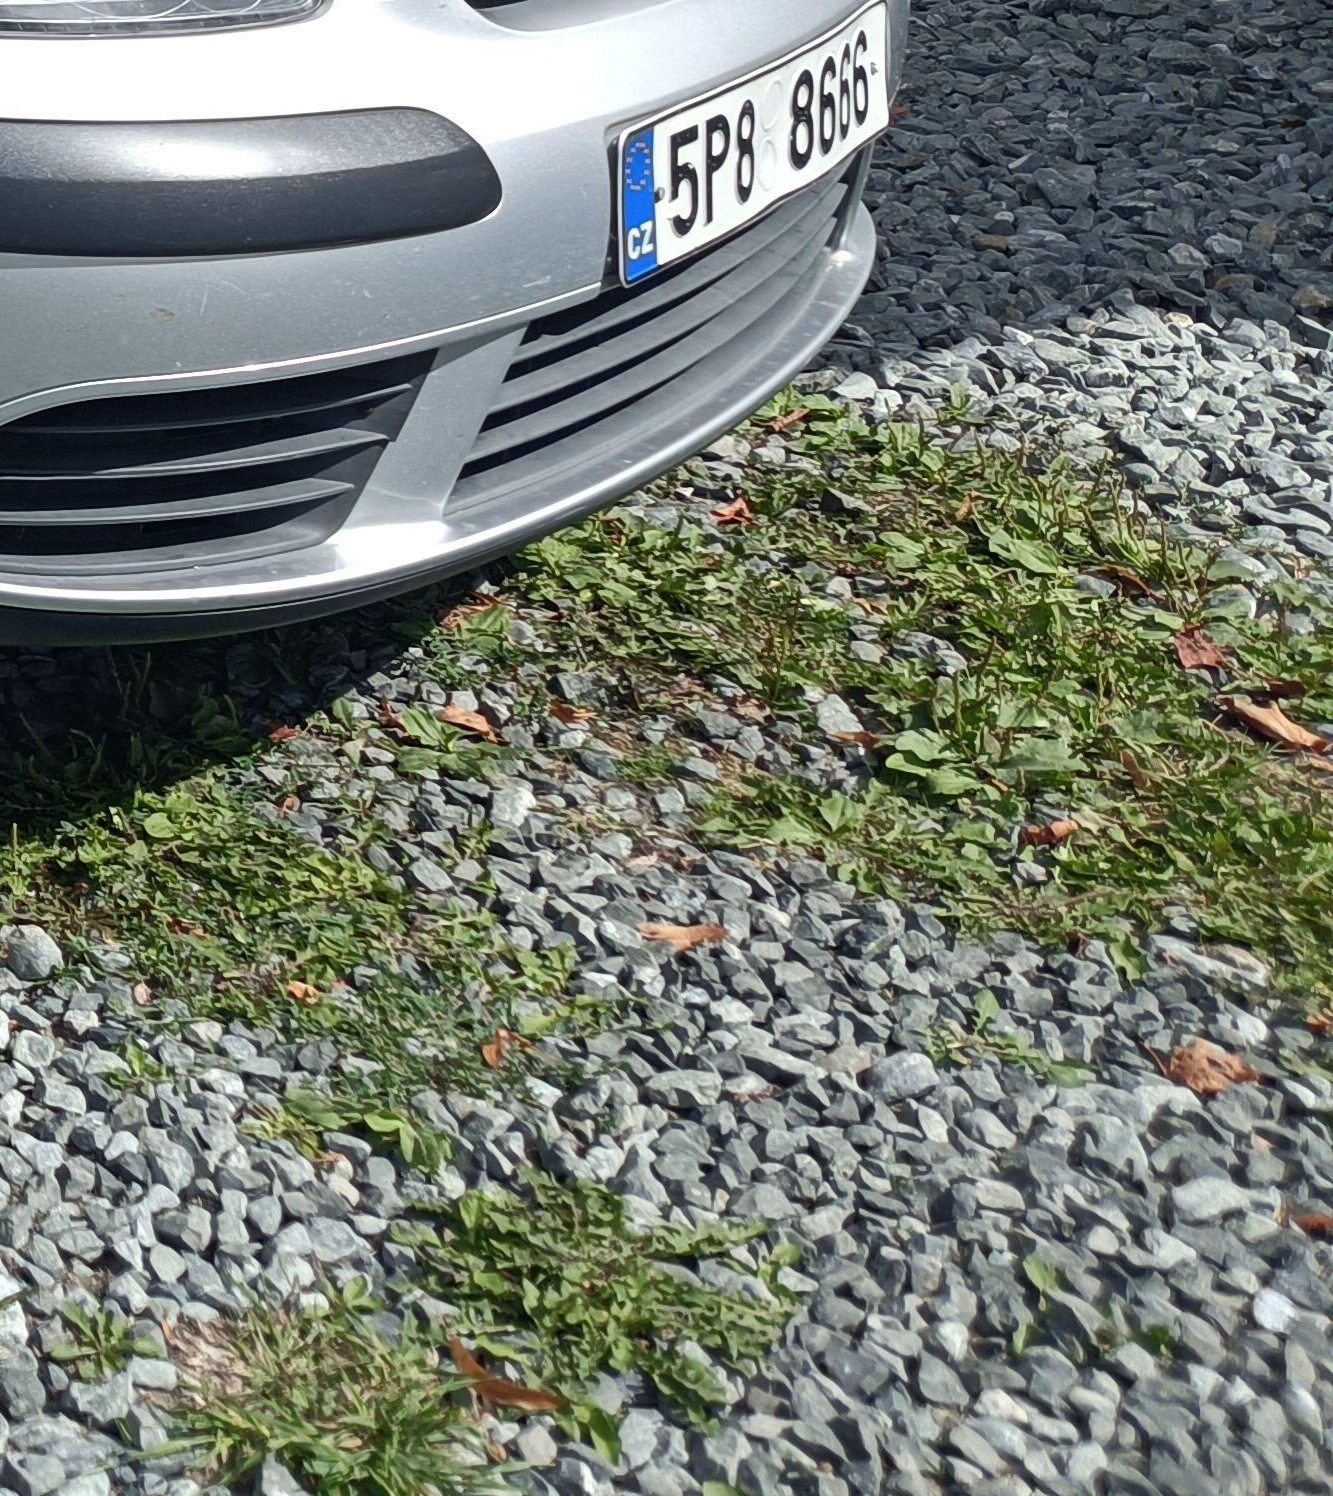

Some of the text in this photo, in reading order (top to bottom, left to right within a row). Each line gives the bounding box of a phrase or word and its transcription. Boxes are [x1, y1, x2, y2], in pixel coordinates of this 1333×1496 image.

[670, 30, 869, 238] 5P8 8666
[628, 221, 654, 261] CZ
